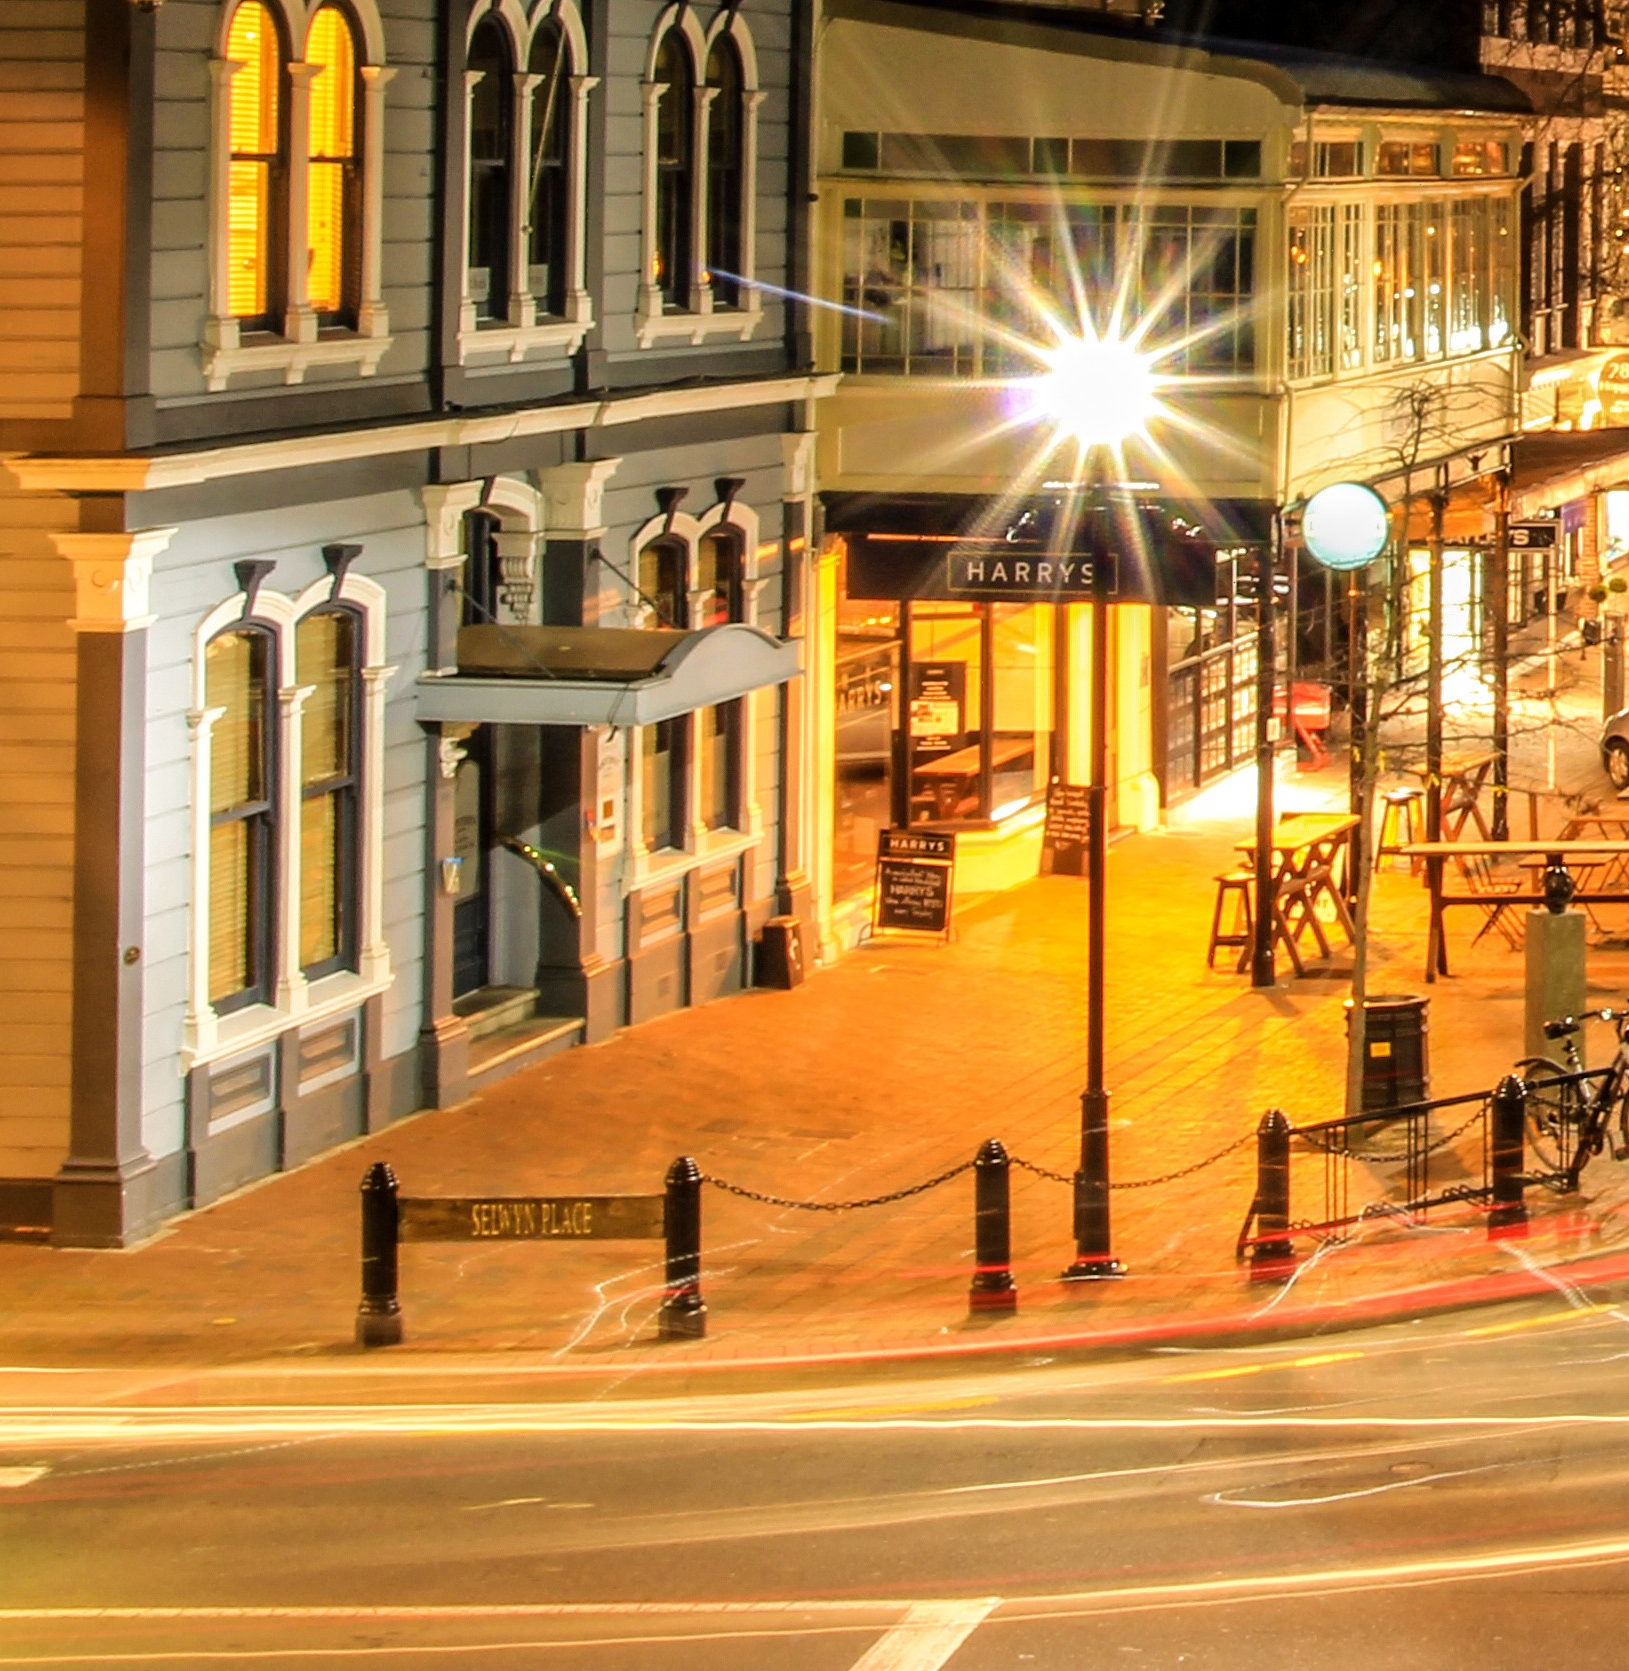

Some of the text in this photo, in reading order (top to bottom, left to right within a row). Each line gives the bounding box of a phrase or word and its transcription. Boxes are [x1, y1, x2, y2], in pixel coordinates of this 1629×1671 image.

[966, 561, 1094, 585] HARRYS
[889, 838, 946, 853] HARRYS
[471, 1203, 593, 1236] SELWYN PLACE
